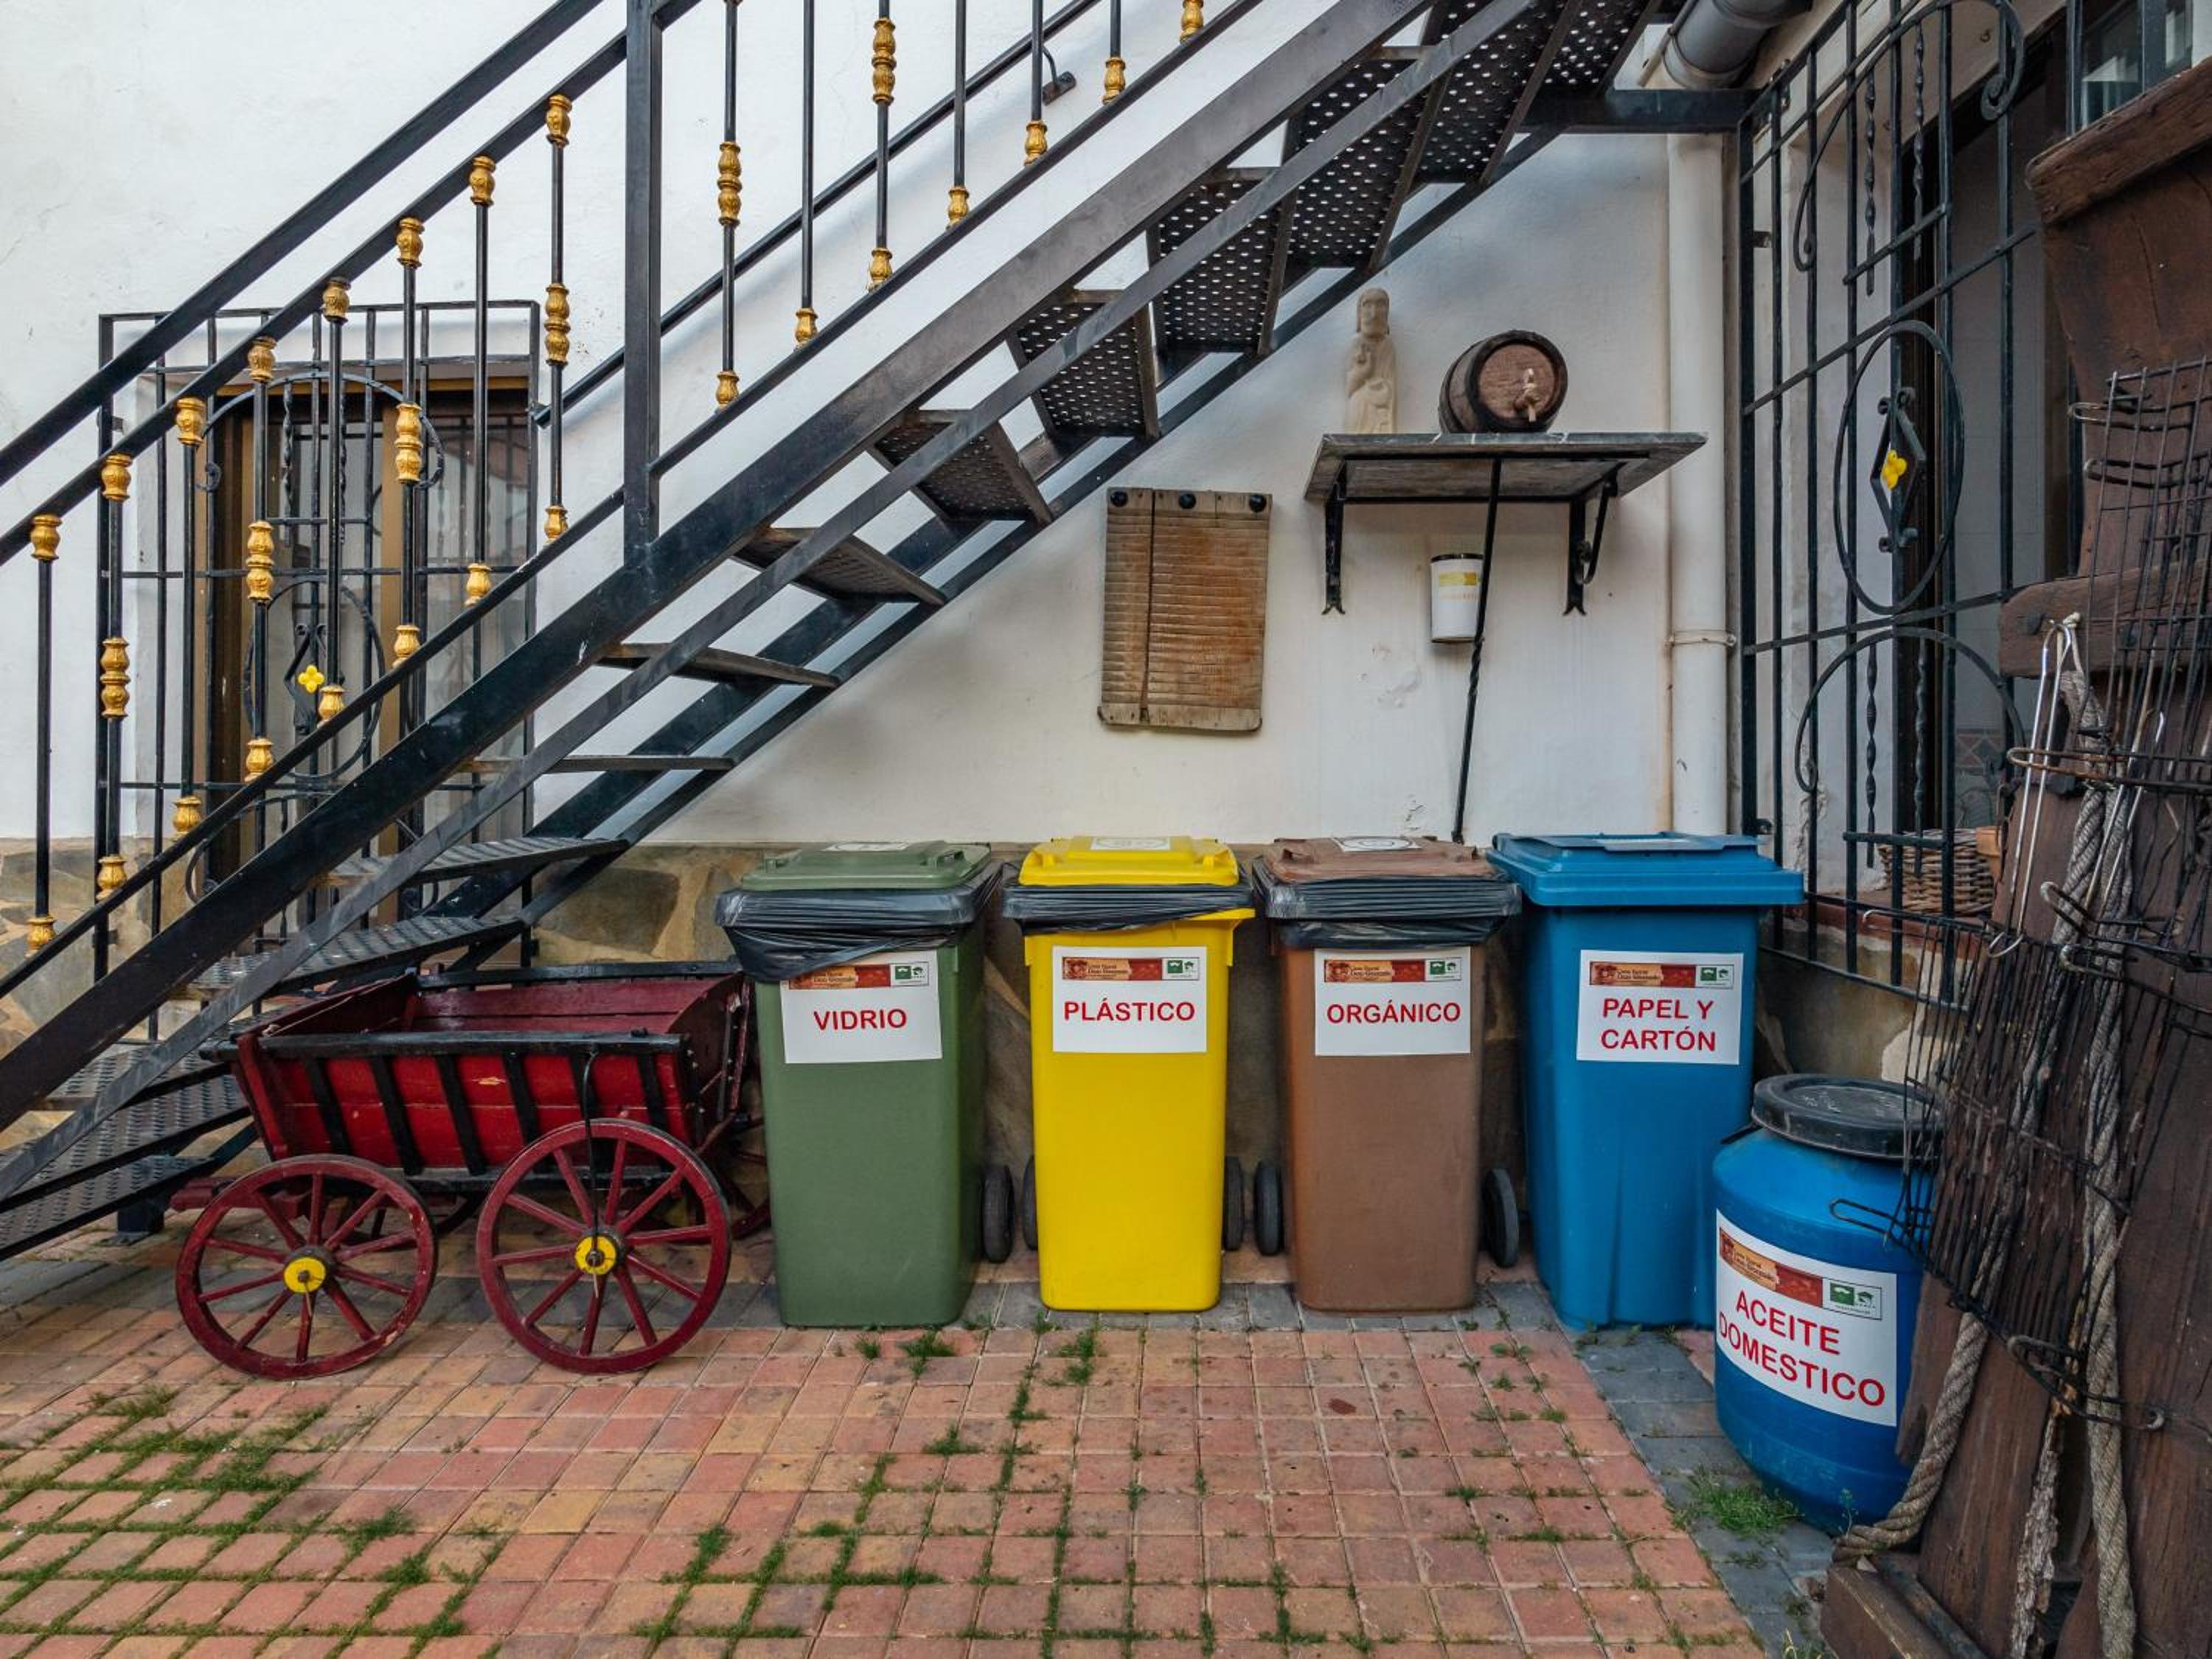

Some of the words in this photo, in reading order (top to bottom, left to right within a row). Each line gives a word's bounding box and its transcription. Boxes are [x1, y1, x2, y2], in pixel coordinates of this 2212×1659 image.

[813, 1009, 907, 1031] VIDRIO
[1063, 997, 1196, 1023] PLÁSTICO
[1326, 999, 1461, 1025] ORGÁNICO
[1602, 998, 1688, 1020] PAPEL
[1697, 1000, 1714, 1020] Y
[1601, 1026, 1717, 1052] CARTÓN
[1736, 1290, 1840, 1355] ACEITE
[1719, 1312, 1885, 1406] DOMESTICO
